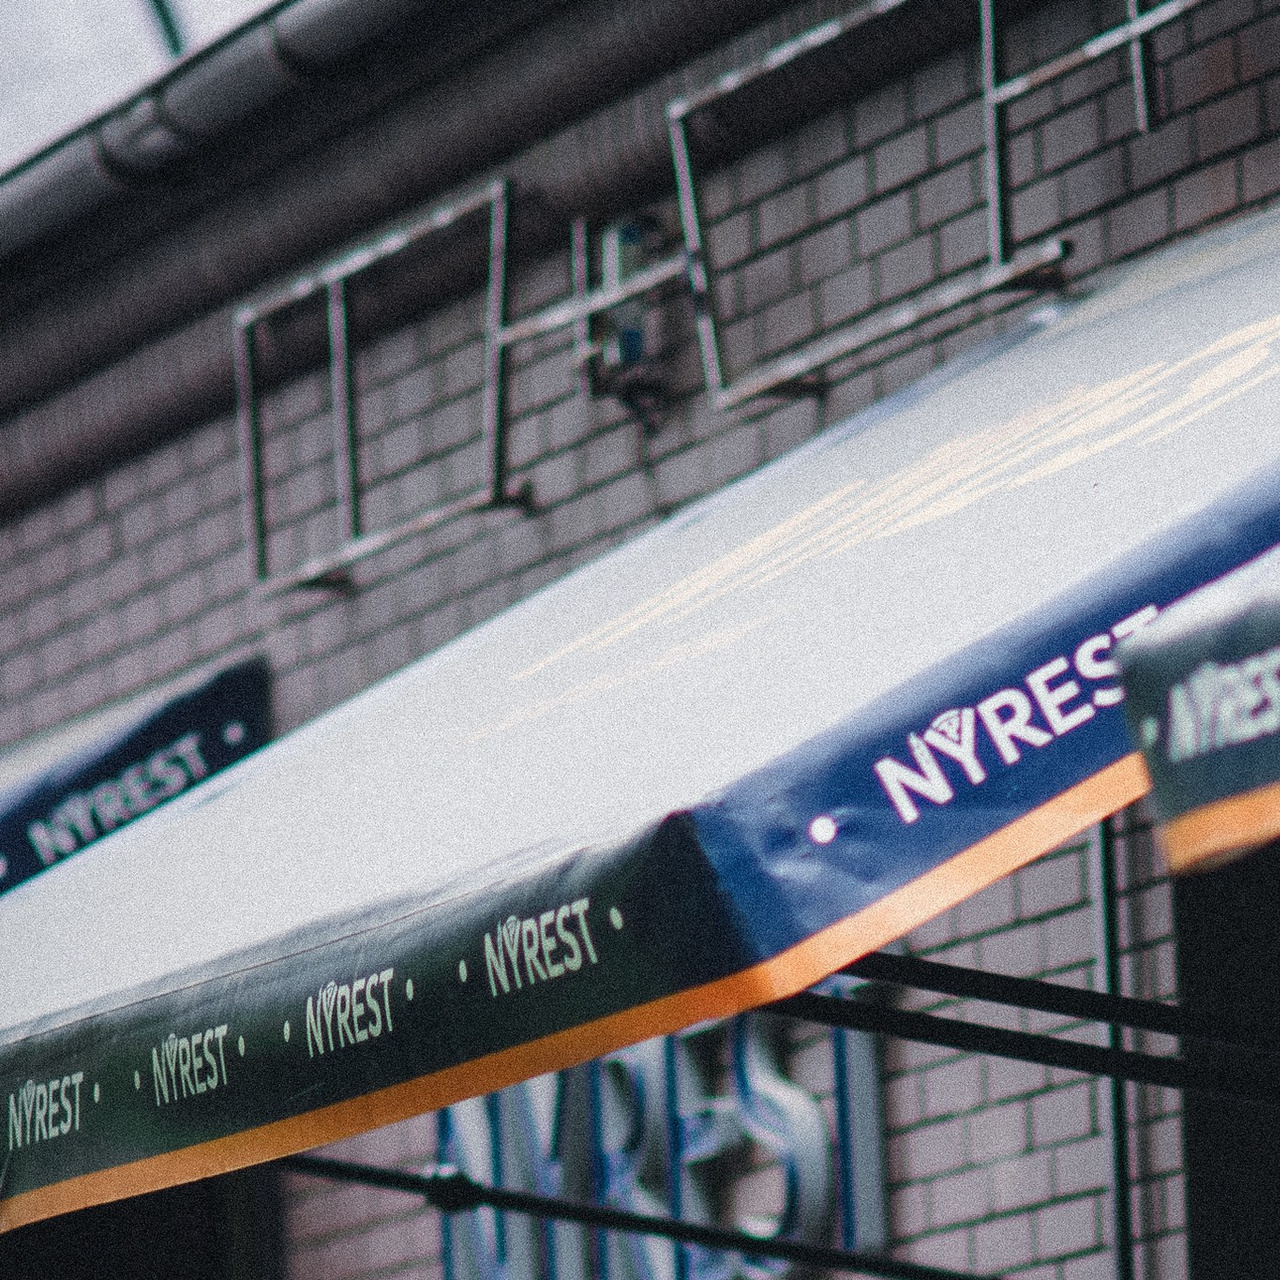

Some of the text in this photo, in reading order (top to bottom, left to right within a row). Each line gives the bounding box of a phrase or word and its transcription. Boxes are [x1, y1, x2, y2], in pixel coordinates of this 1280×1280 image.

[27, 732, 207, 864] NYREST
[7, 898, 598, 1150] NYREST NYREST NYREST NYREST
